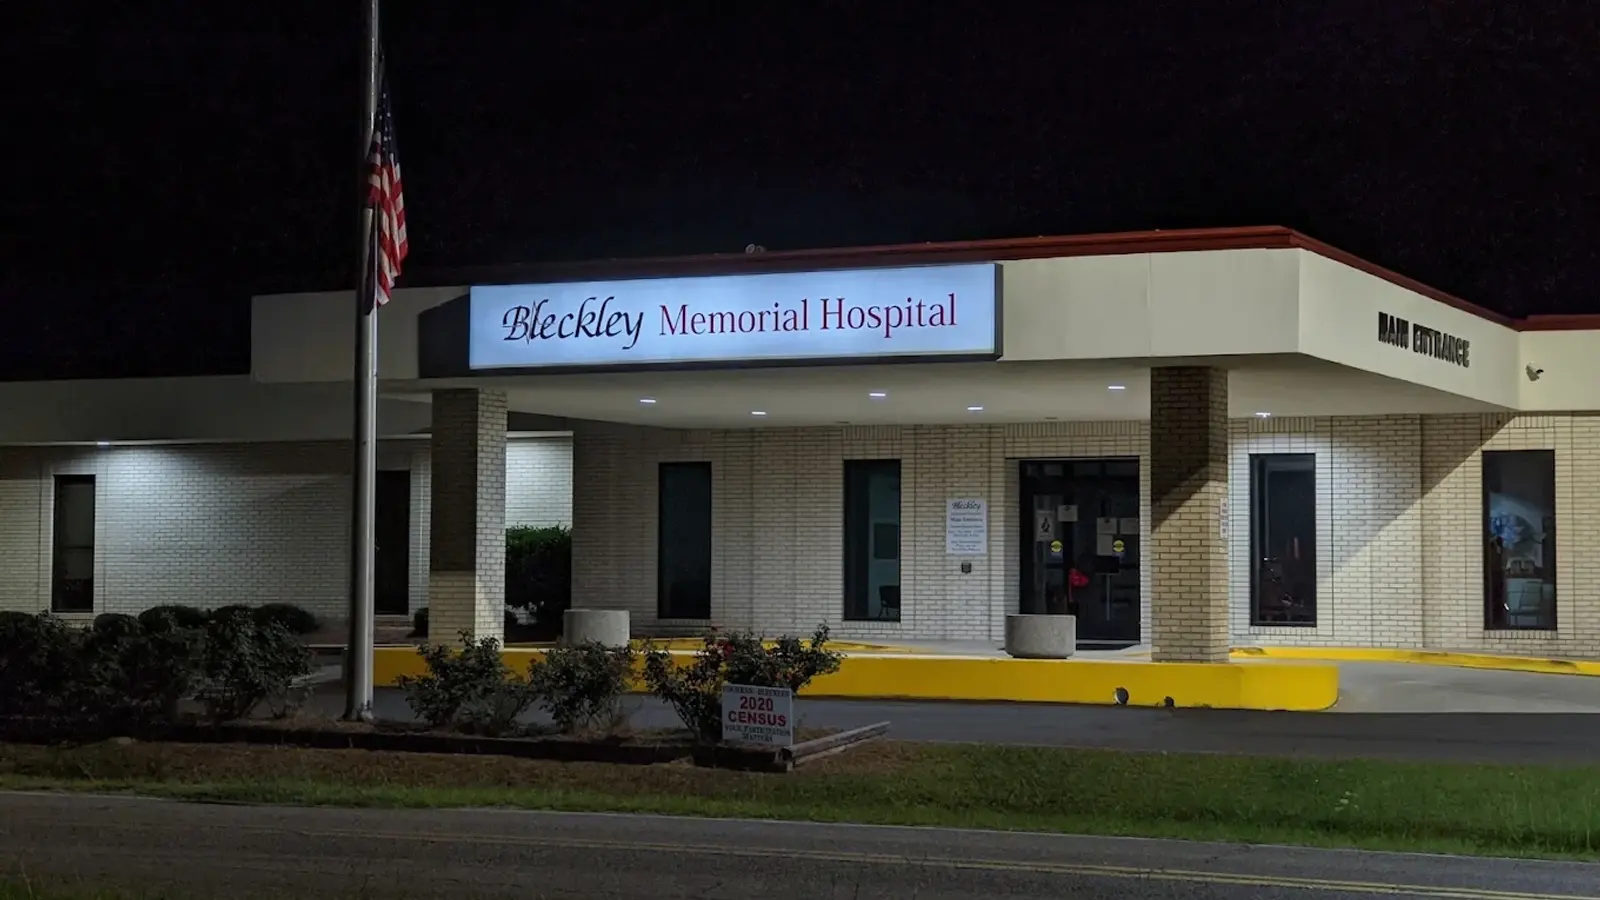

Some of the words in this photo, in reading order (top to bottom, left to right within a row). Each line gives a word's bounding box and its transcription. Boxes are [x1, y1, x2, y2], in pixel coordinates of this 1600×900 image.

[502, 296, 644, 350] Bleckley
[659, 298, 810, 336] Memorial
[820, 293, 958, 339] Hospital
[1378, 311, 1409, 350] MAIN
[1413, 323, 1470, 368] ENTRANCE
[728, 710, 787, 727] CENSUS
[740, 695, 774, 712] 2020
